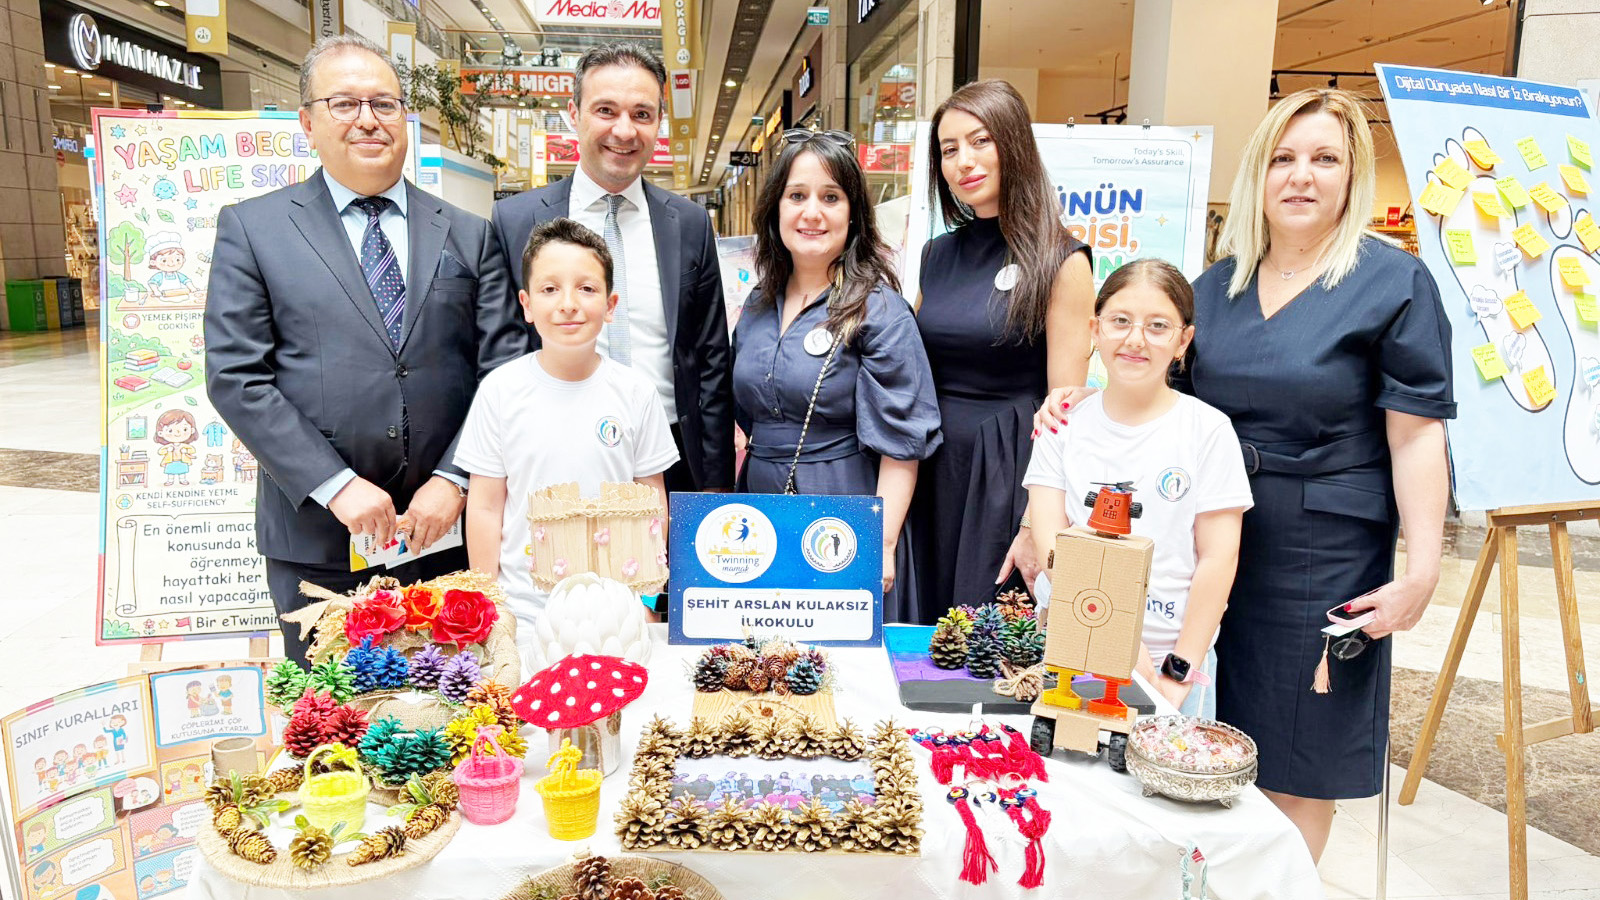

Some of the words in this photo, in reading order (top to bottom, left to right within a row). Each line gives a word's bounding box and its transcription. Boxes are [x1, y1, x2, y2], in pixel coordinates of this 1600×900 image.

[546, 0, 607, 17] Media
[1394, 75, 1425, 92] Dijital
[1425, 78, 1473, 95] Dünyada
[1496, 85, 1510, 98] Bir
[114, 133, 226, 170] YAŞAM
[236, 131, 318, 158] BECE
[1134, 147, 1164, 156] Today's
[1166, 148, 1184, 157] Skill,
[1093, 157, 1139, 165] Tomorrow's
[1142, 158, 1184, 166] Assurance
[184, 165, 244, 193] LIFE
[142, 313, 172, 321] YEMEK
[158, 322, 195, 330] COOKING
[208, 488, 239, 497] YETME
[147, 498, 227, 509] SELF-SUFFICIENCY
[143, 524, 160, 537] En
[166, 521, 211, 536] önemli
[167, 537, 241, 552] konusunda
[711, 555, 760, 567] eTwinning
[163, 573, 232, 590] hayattaki
[238, 571, 261, 584] her
[160, 591, 192, 605] nasıl
[687, 596, 729, 611] ŞEHİT
[734, 599, 791, 610] ARSLAN
[796, 601, 869, 611] KULAKSIZ
[196, 616, 216, 628] Bir
[741, 614, 814, 628] İLKOKULU
[15, 724, 50, 749] SINIF
[55, 700, 139, 731] KURALLARI
[171, 728, 215, 739] KUTUSUNA
